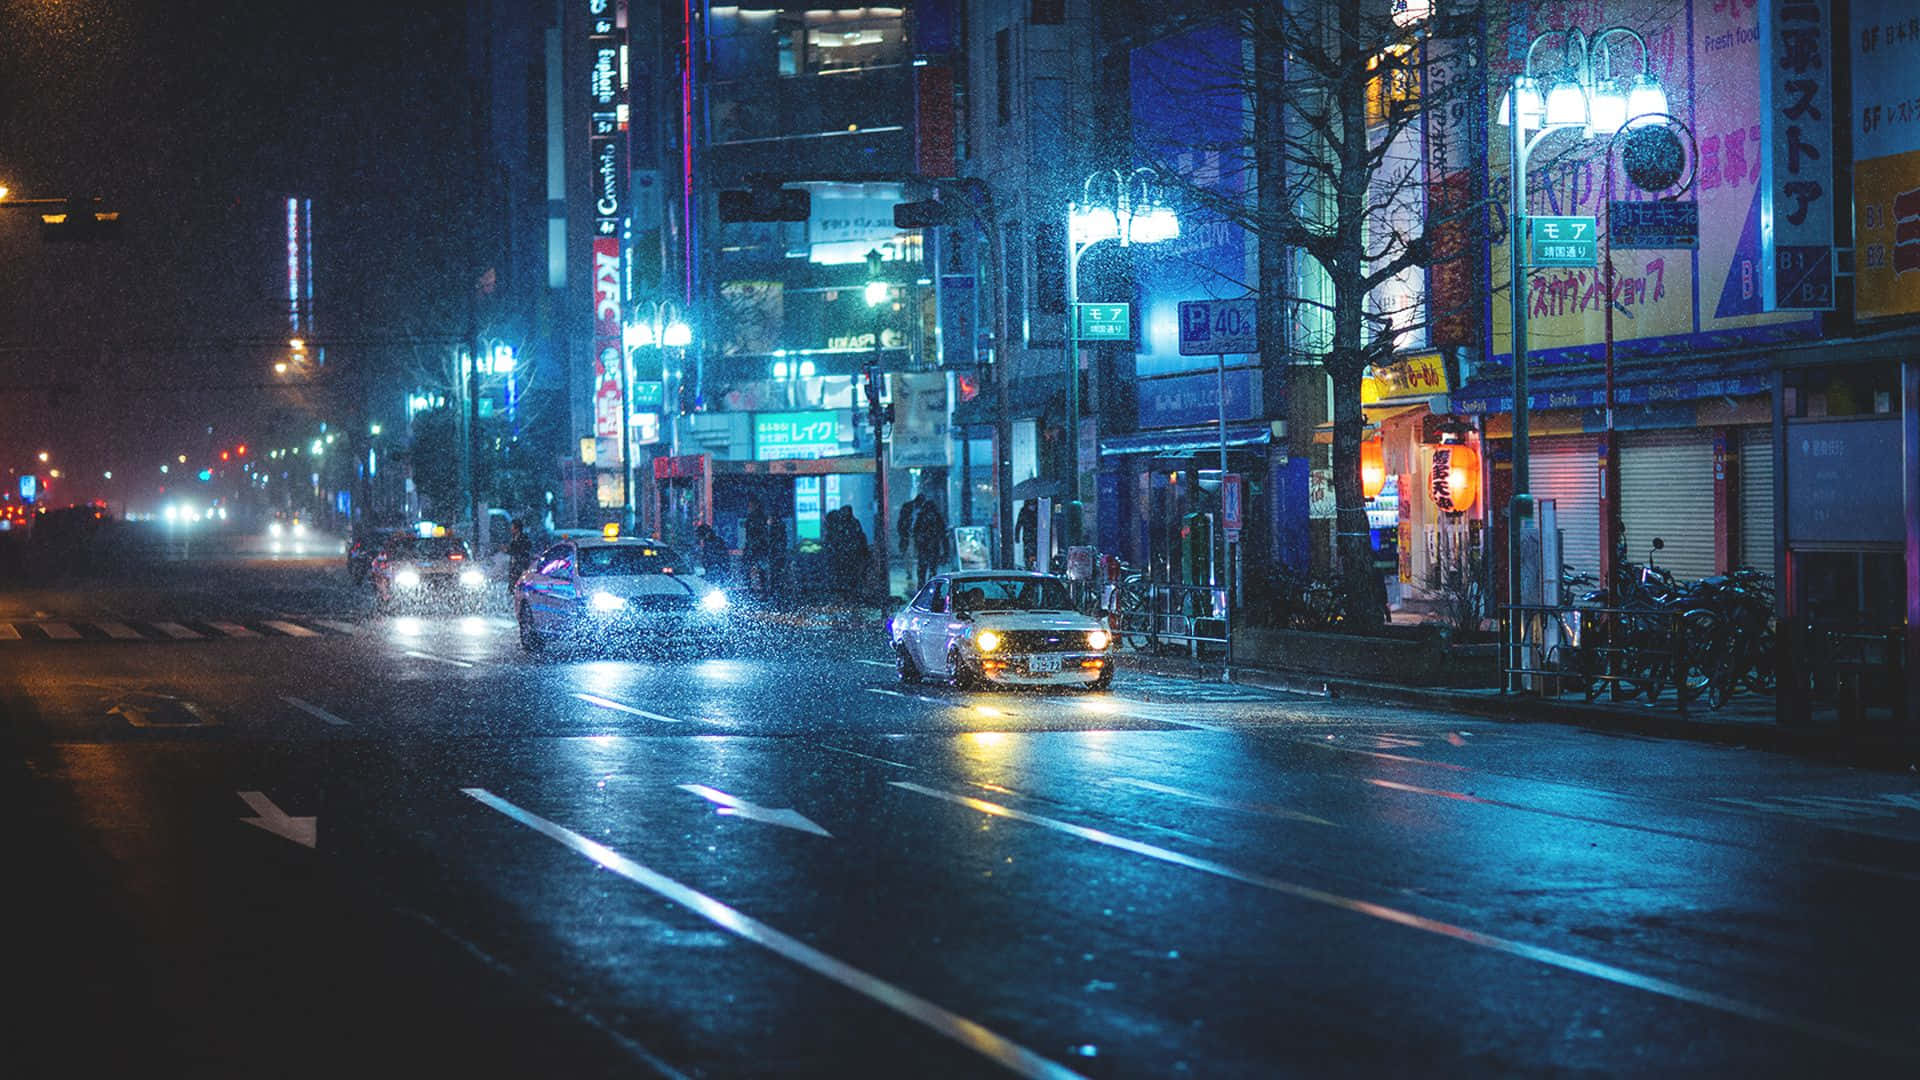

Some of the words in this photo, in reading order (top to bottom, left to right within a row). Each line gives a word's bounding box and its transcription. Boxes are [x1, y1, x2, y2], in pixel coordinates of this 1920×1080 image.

[1705, 30, 1733, 52] Fresh
[1737, 21, 1761, 45] food
[595, 49, 617, 104] Euphoria
[1544, 223, 1587, 239] モア
[1544, 246, 1587, 258] 靖国通り
[597, 252, 622, 321] KFC
[1089, 308, 1122, 321] モア
